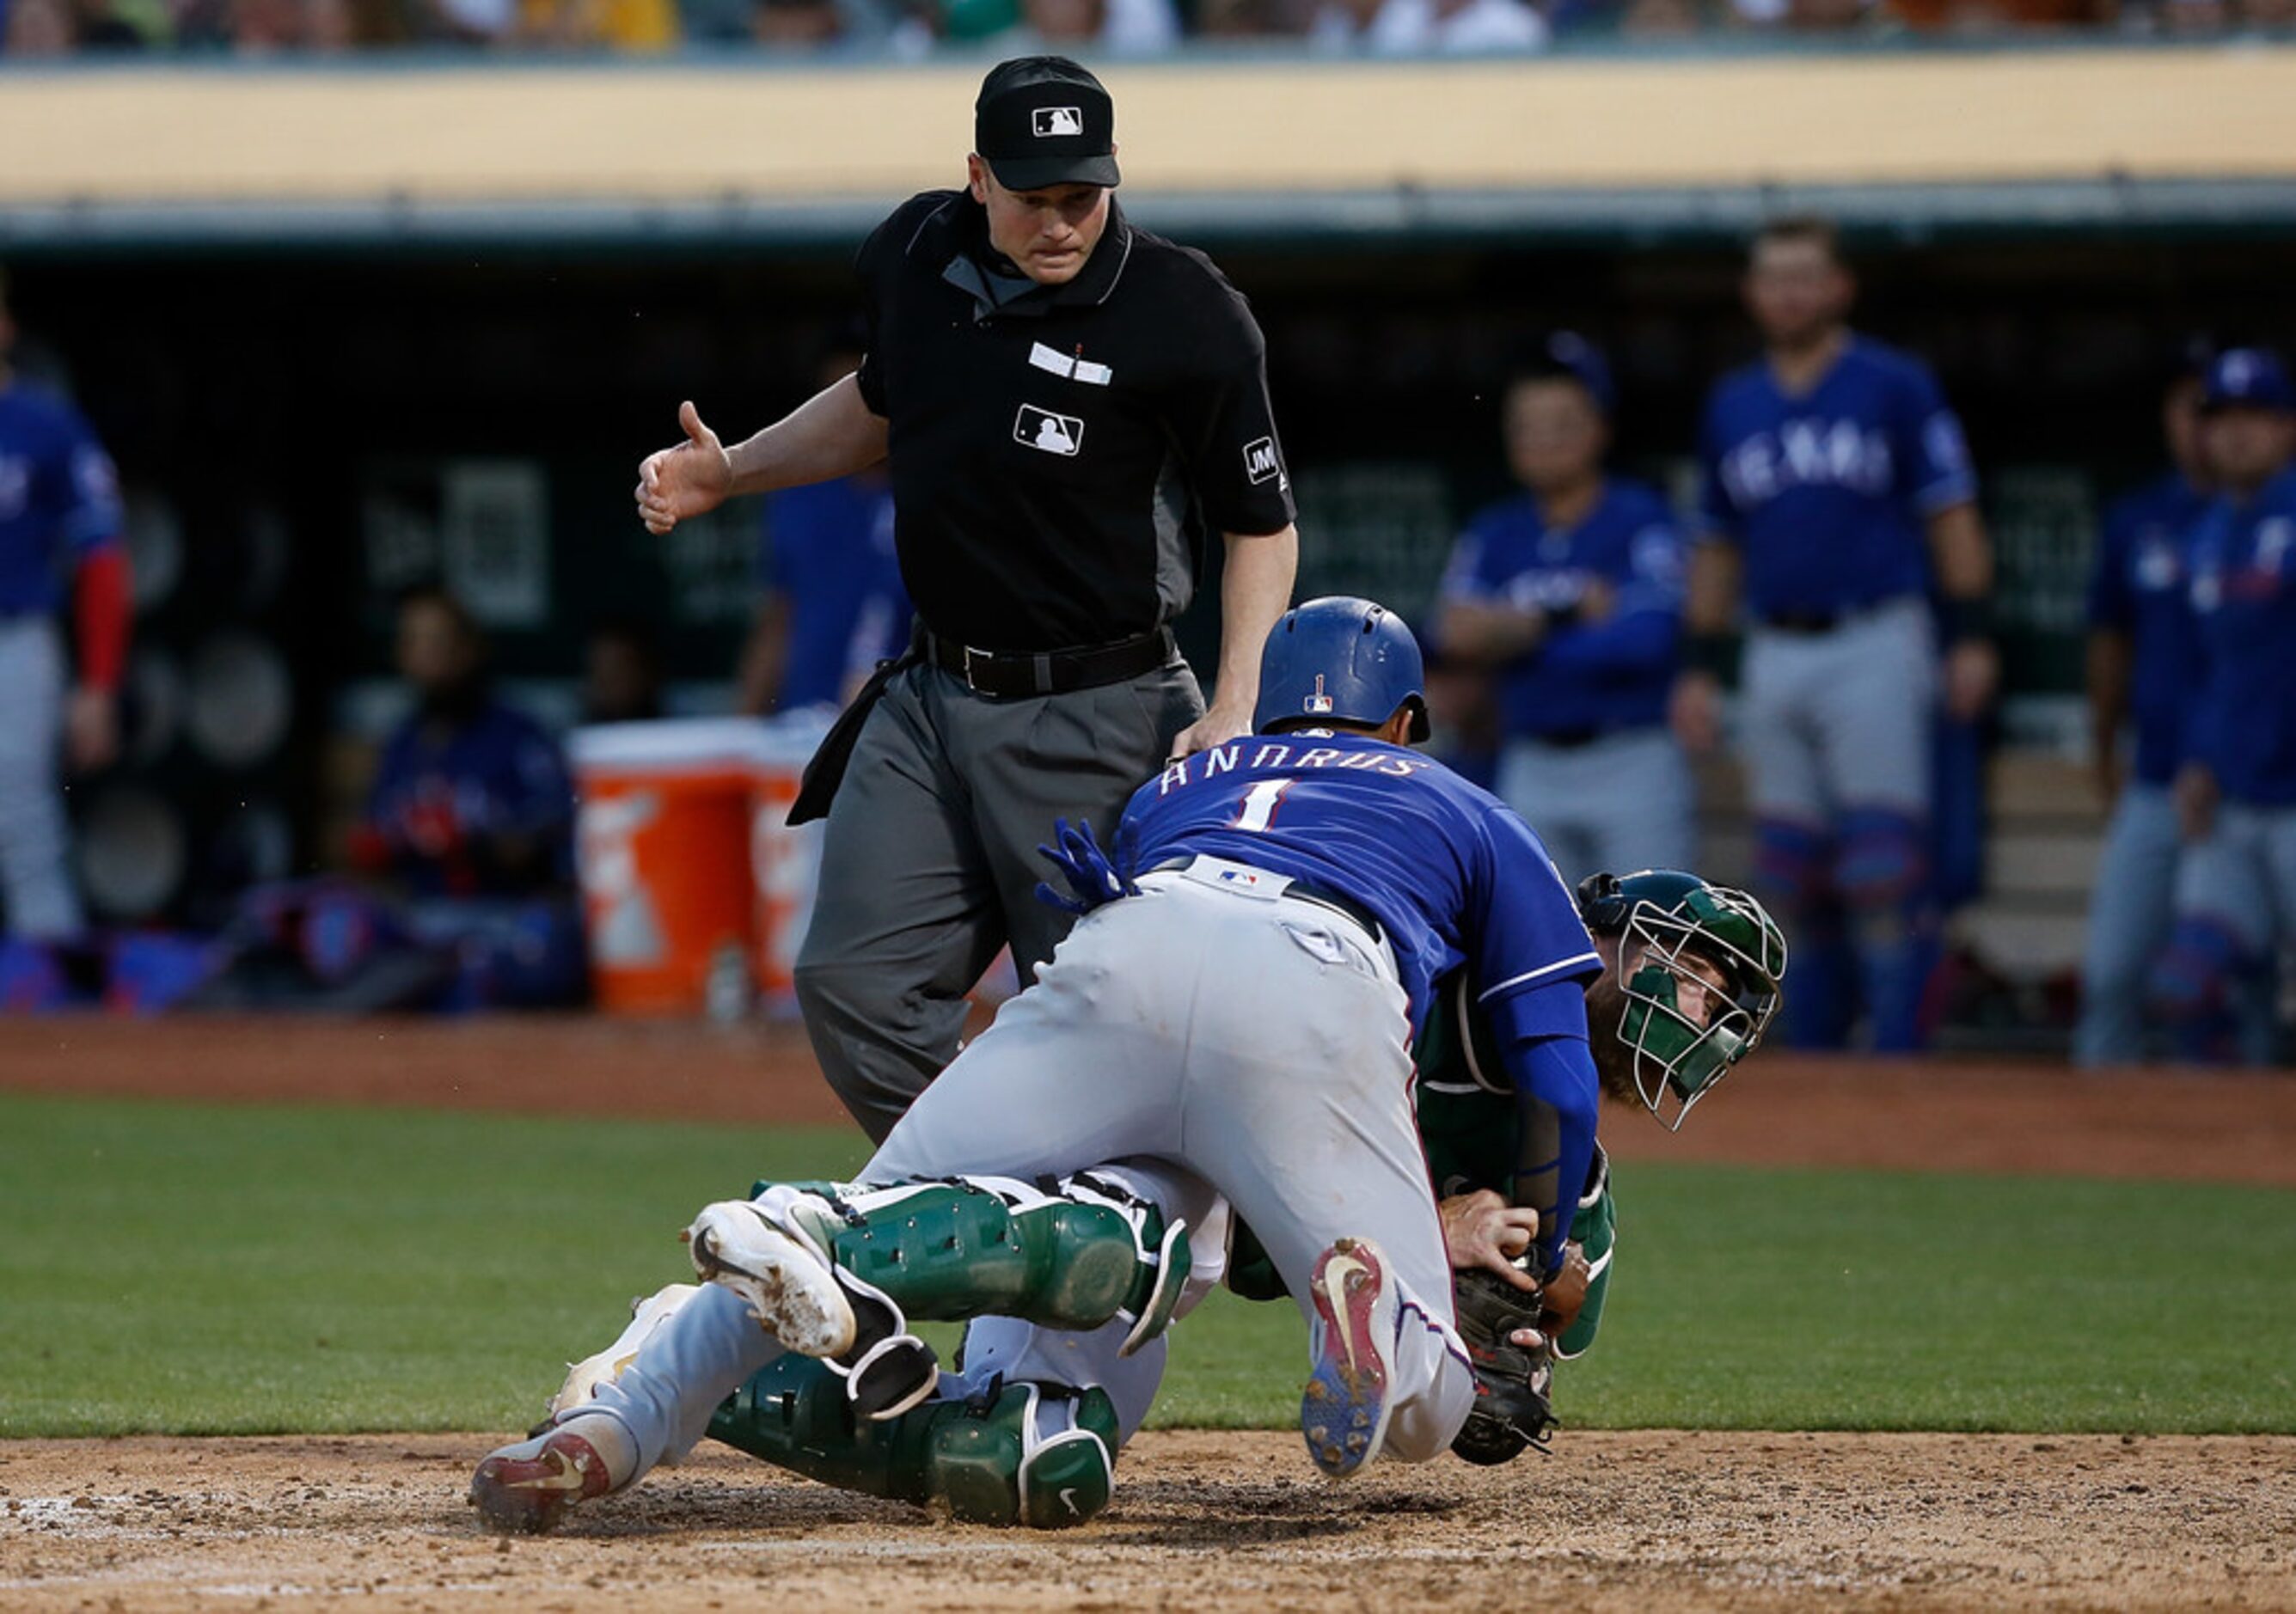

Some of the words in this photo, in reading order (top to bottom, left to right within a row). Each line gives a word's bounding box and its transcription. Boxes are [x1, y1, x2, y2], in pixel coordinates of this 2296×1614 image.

[1250, 445, 1276, 474] JM
[1158, 744, 1429, 797] ANDRUS
[1225, 775, 1300, 834] 1
